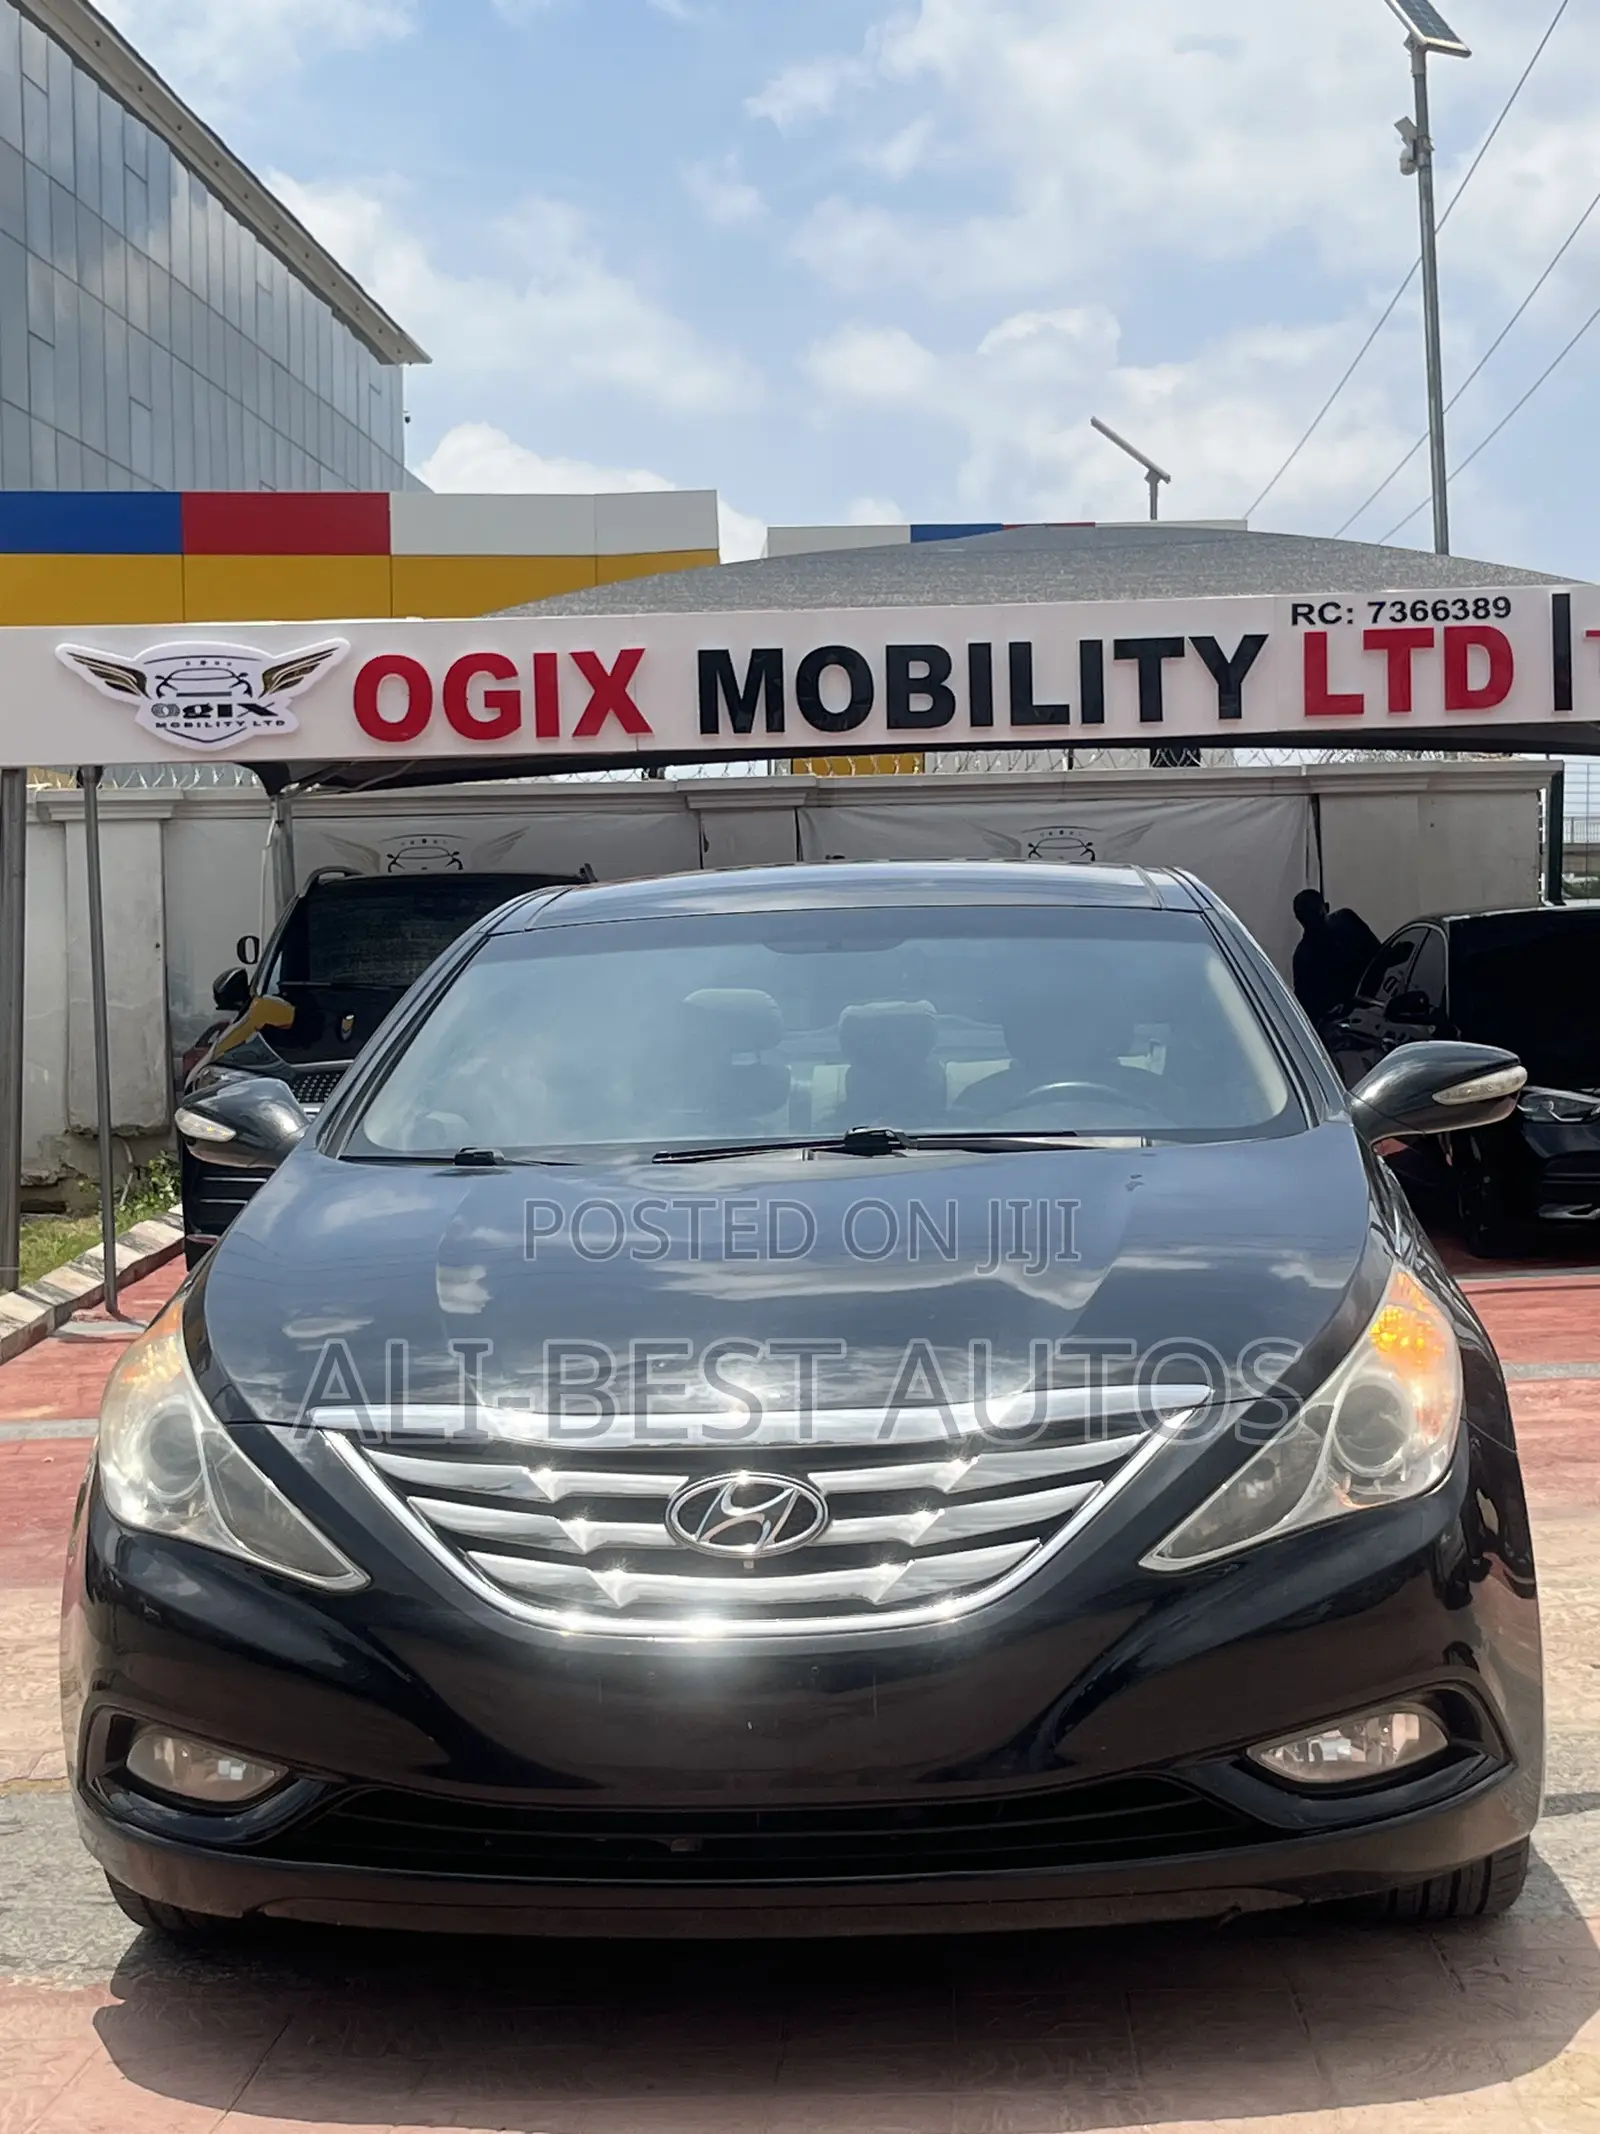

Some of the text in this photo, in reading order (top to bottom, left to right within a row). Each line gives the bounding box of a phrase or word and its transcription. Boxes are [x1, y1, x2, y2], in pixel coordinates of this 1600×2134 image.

[1291, 596, 1512, 625] RC: 7366389
[353, 648, 653, 742] OGIX
[698, 634, 1268, 735] MOBILITY
[1304, 625, 1514, 716] LTD
